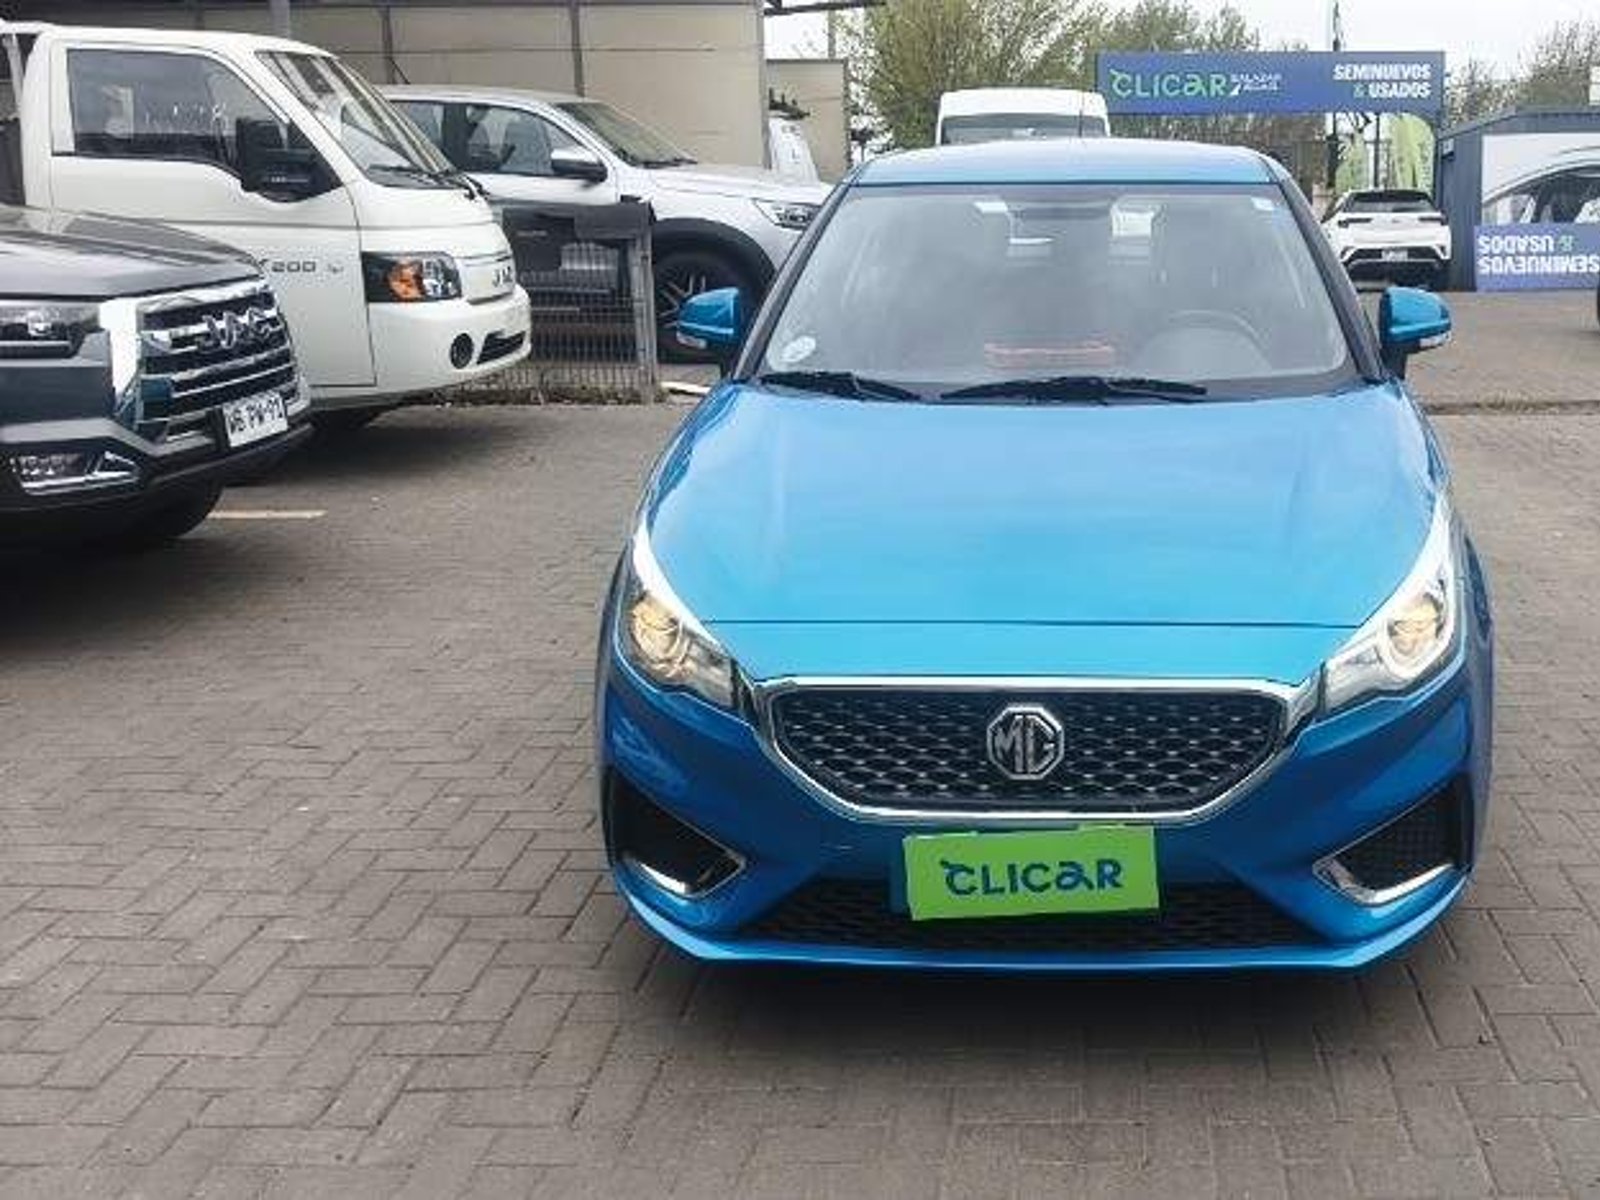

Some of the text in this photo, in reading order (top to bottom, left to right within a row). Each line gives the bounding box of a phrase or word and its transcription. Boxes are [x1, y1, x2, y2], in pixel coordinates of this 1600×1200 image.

[1333, 63, 1431, 80] SEMINUEVOS
[1368, 82, 1431, 98] USADOS
[994, 714, 1055, 773] MG
